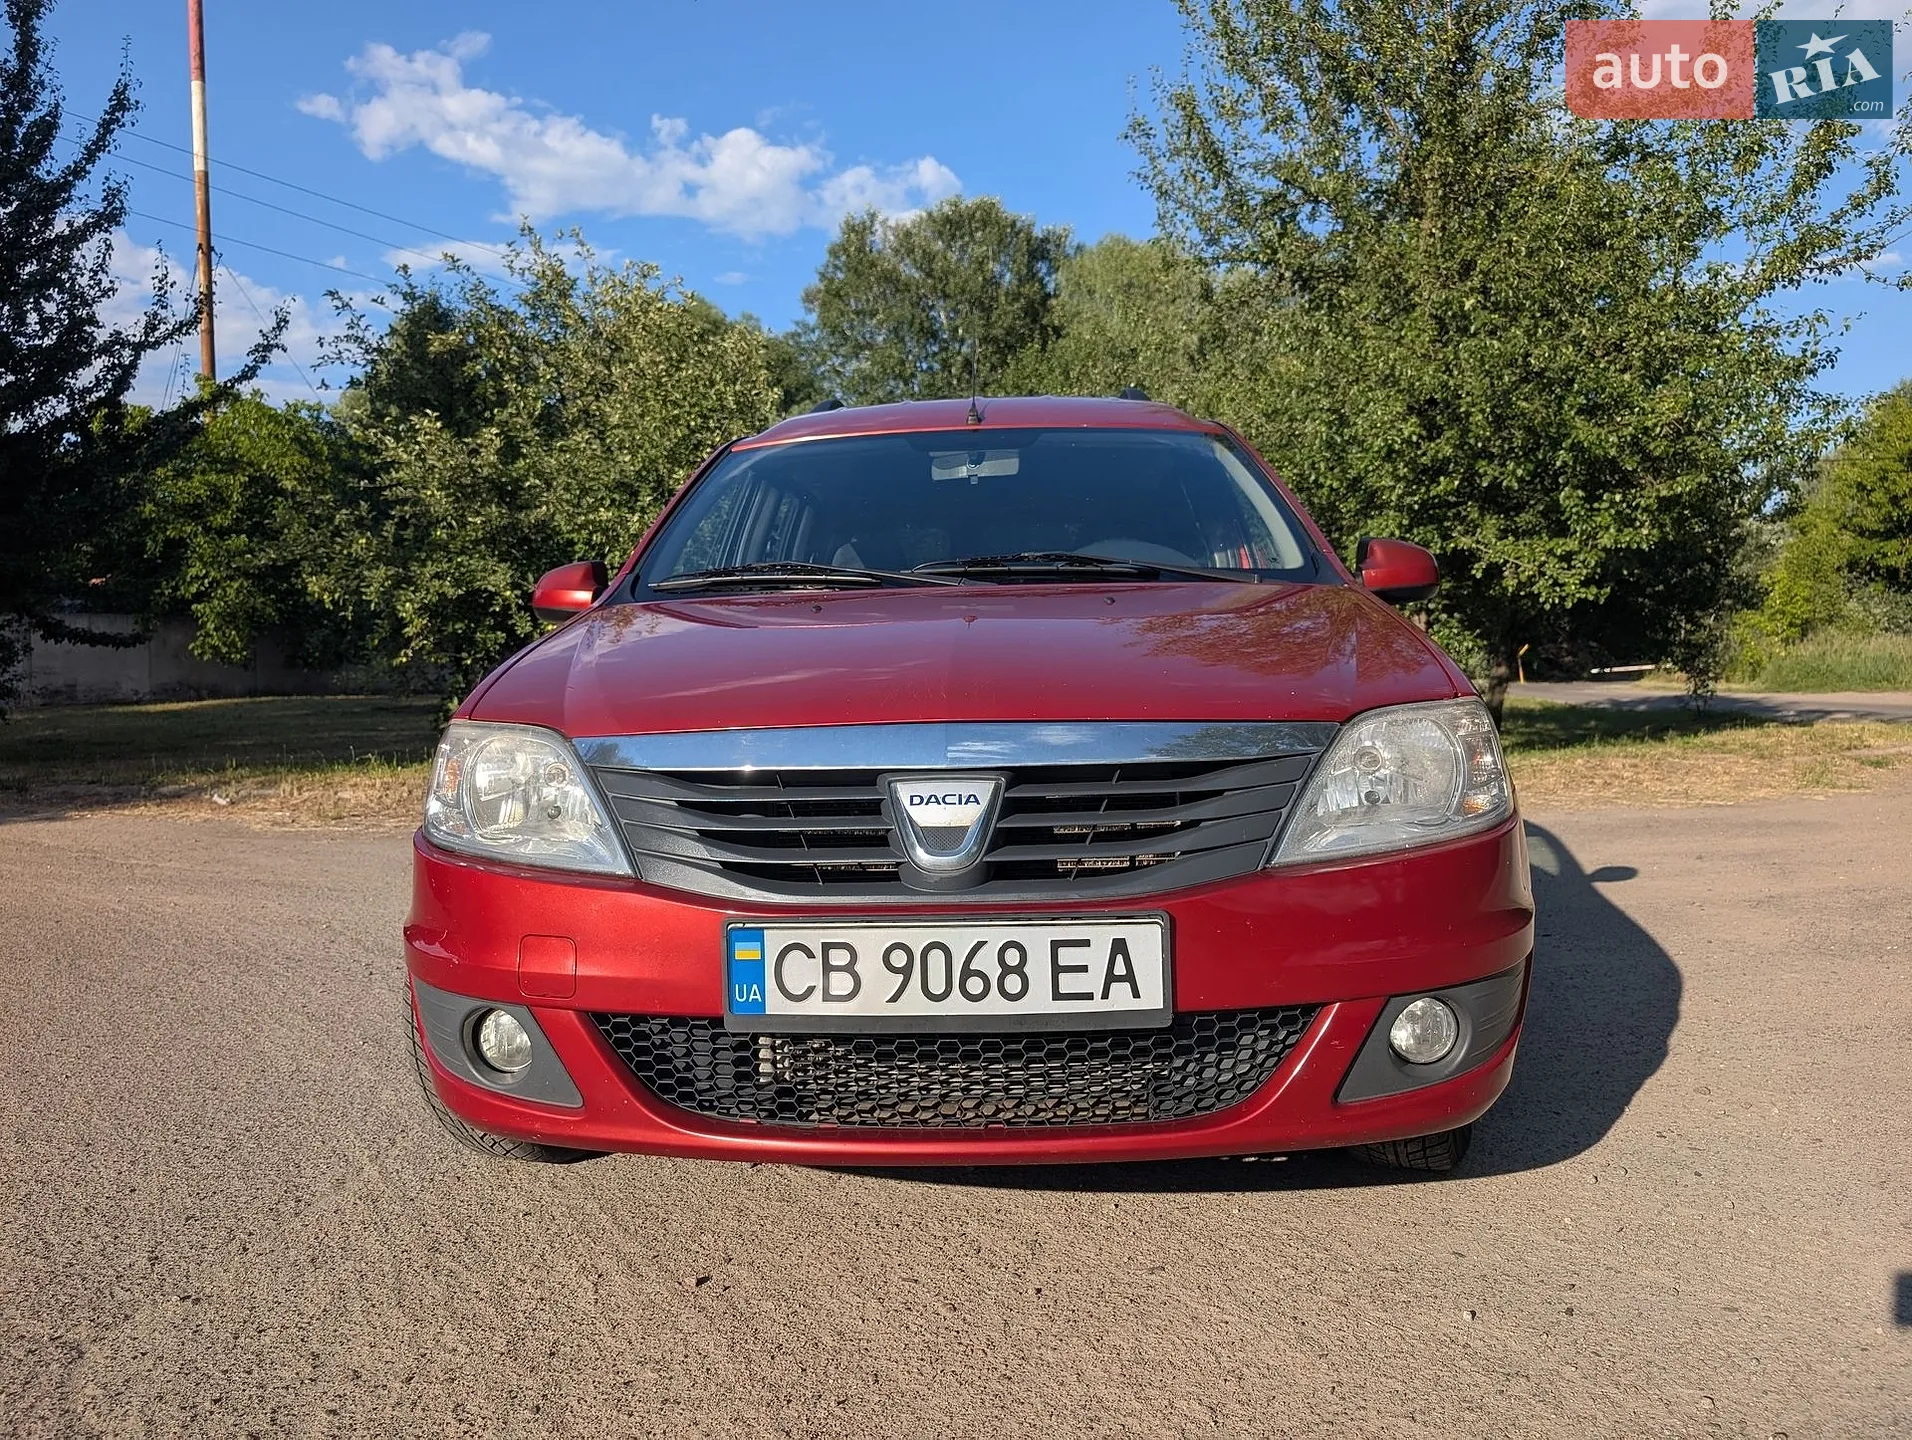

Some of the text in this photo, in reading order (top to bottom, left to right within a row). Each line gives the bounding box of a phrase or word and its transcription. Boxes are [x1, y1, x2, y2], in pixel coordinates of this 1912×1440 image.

[909, 793, 981, 806] DACIA
[773, 938, 1141, 1003] CB 9068 EA
[734, 984, 762, 1003] UA
